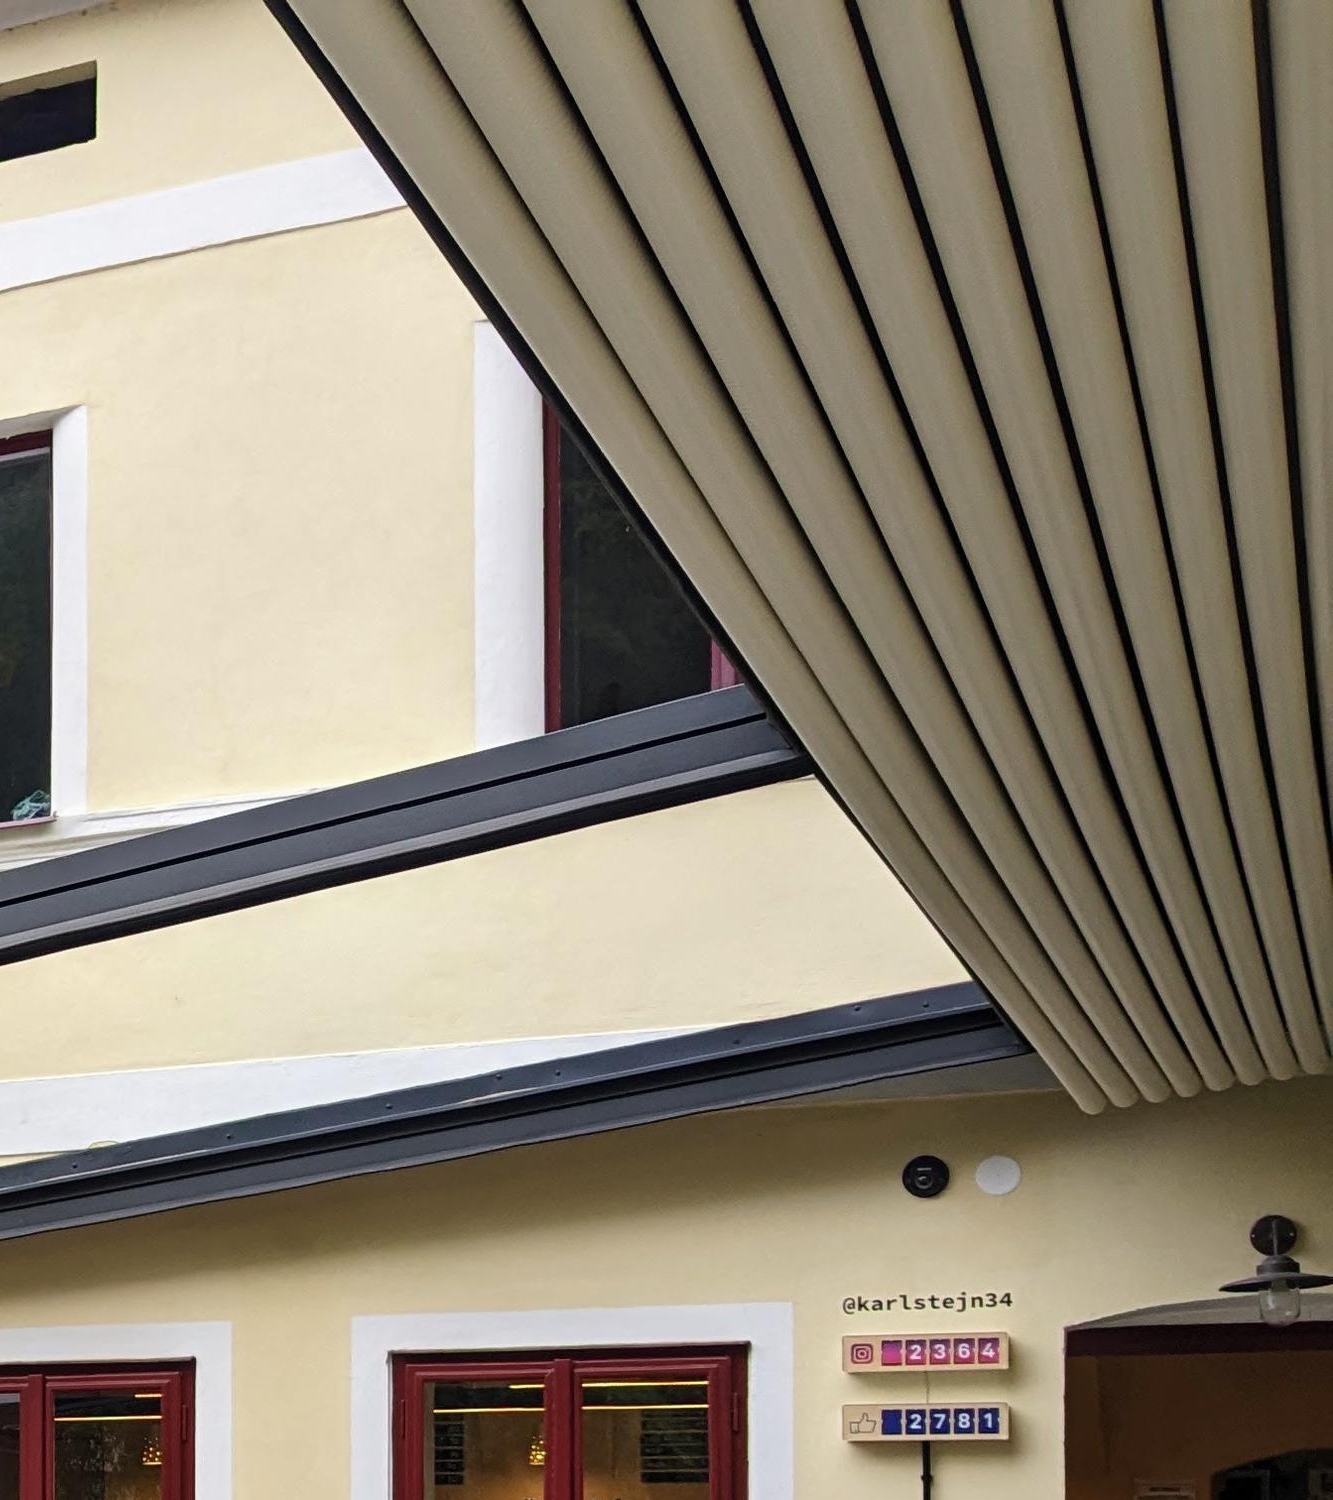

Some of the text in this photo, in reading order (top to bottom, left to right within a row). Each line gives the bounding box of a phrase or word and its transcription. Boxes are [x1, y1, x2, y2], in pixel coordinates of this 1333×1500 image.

[842, 1291, 1013, 1315] @karlstejn34
[909, 1342, 996, 1361] 2364
[909, 1412, 994, 1430] 2781
